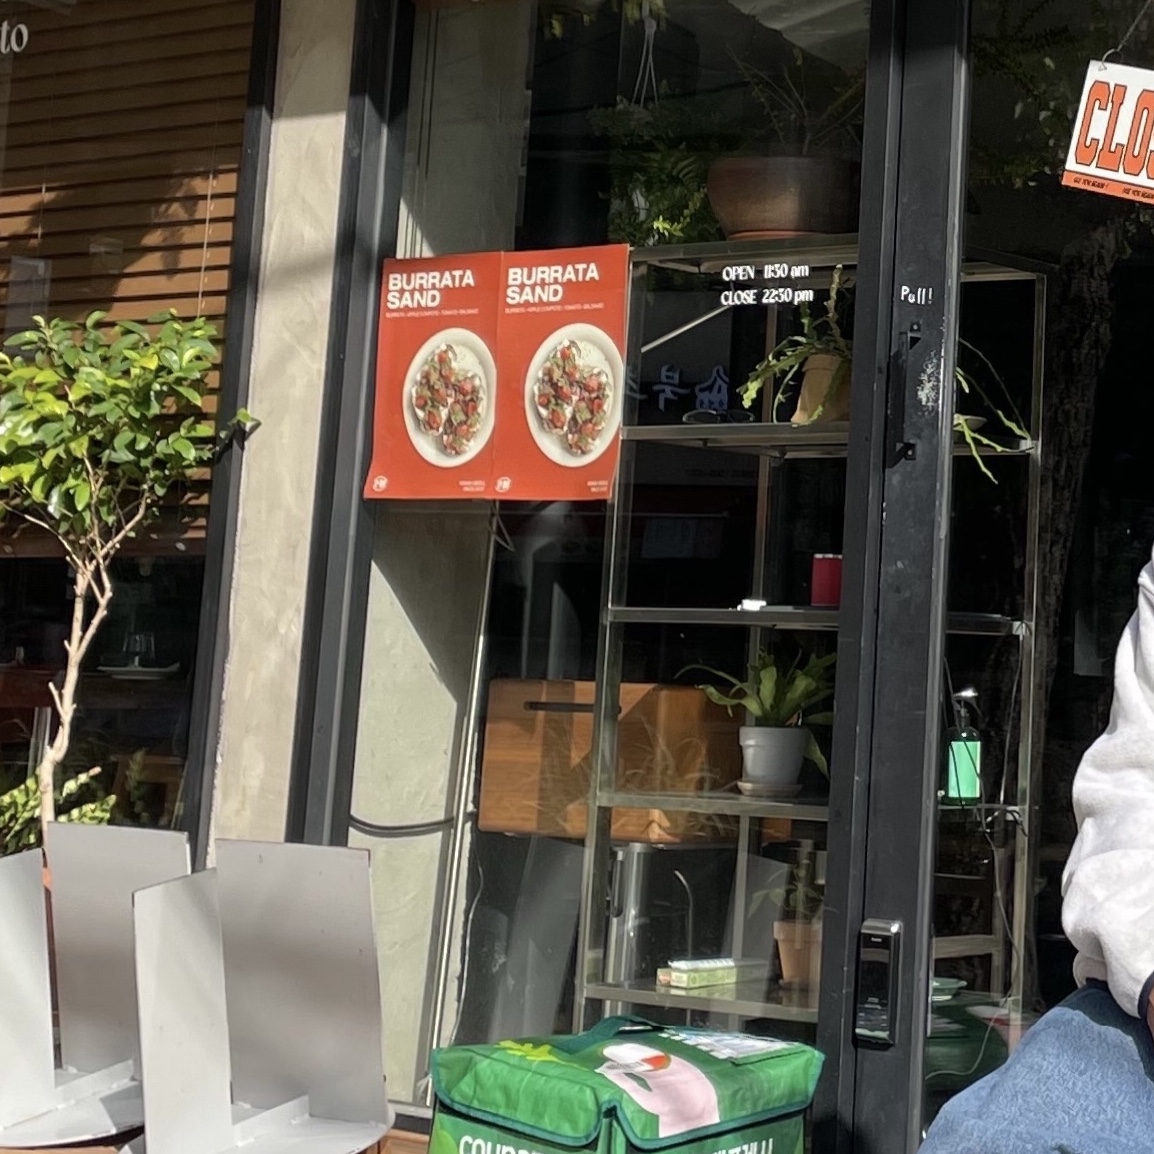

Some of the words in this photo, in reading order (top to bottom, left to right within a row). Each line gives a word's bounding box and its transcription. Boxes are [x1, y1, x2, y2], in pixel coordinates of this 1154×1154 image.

[388, 270, 475, 291] BURRATA
[508, 263, 600, 286] BURRATA
[722, 265, 755, 282] OPEN
[790, 265, 810, 279] am
[386, 291, 441, 310] SAND
[505, 284, 564, 305] SAND
[720, 289, 758, 306] CLOSE
[762, 287, 793, 304] 22:30
[793, 289, 814, 306] pm
